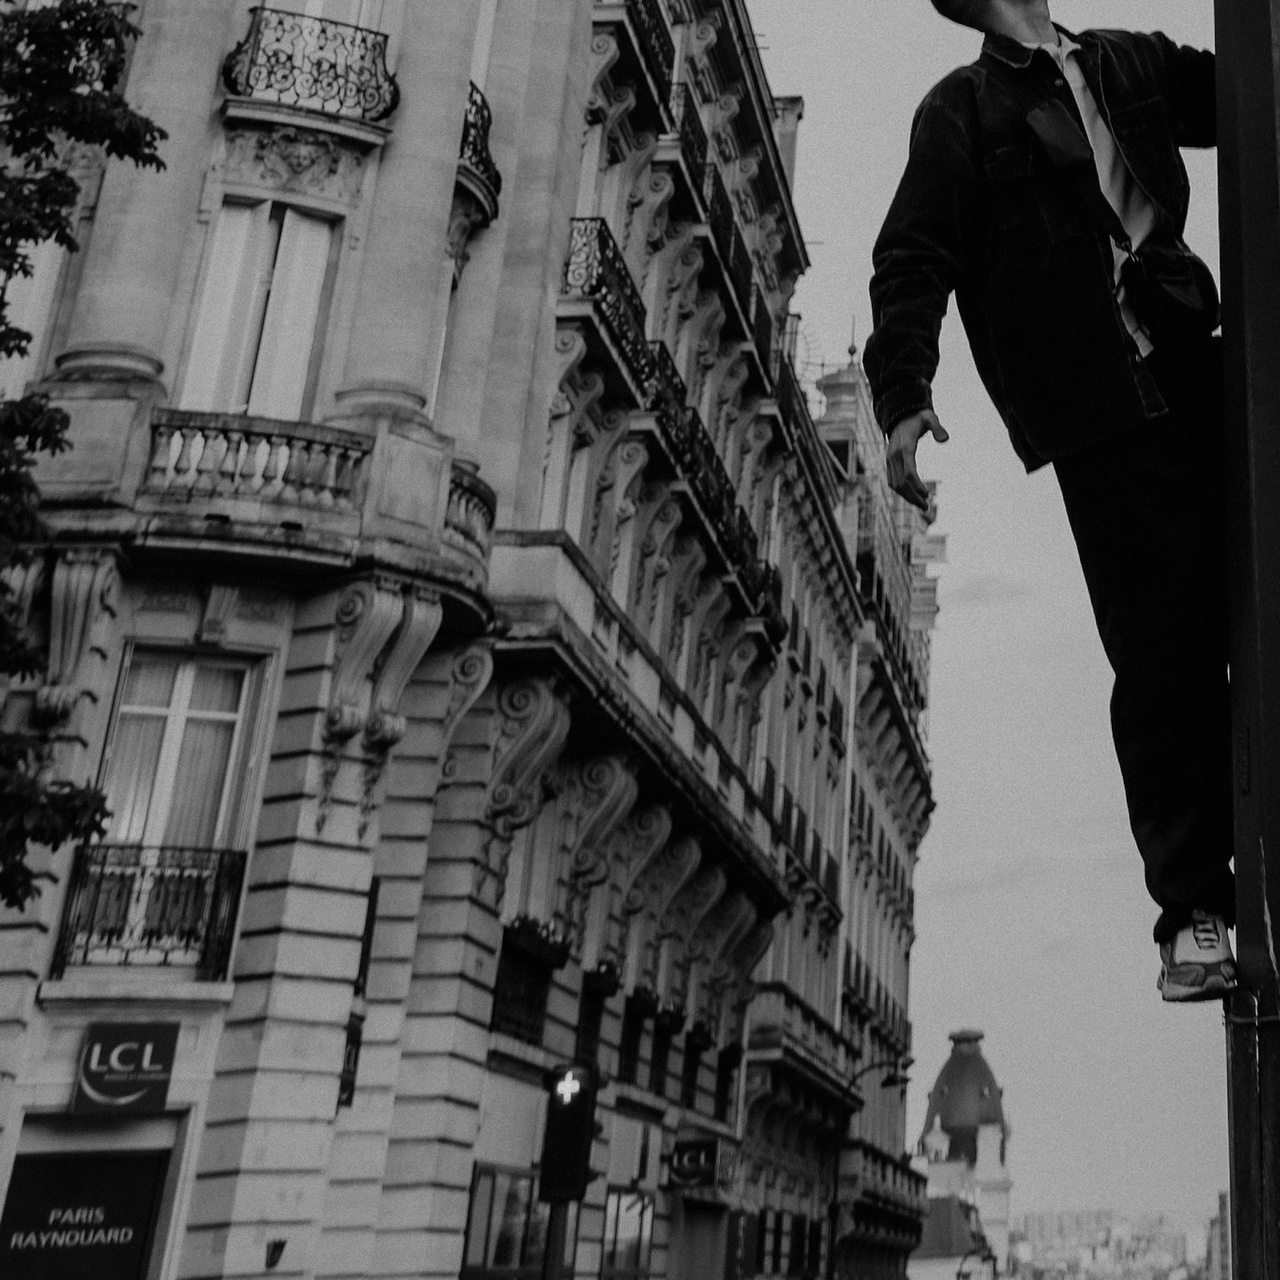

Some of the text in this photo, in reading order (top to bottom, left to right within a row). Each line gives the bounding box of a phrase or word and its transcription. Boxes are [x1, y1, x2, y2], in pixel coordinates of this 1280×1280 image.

[88, 1041, 164, 1072] LCL
[48, 1206, 105, 1226] PARIS
[10, 1226, 134, 1249] RAYNOUARD
